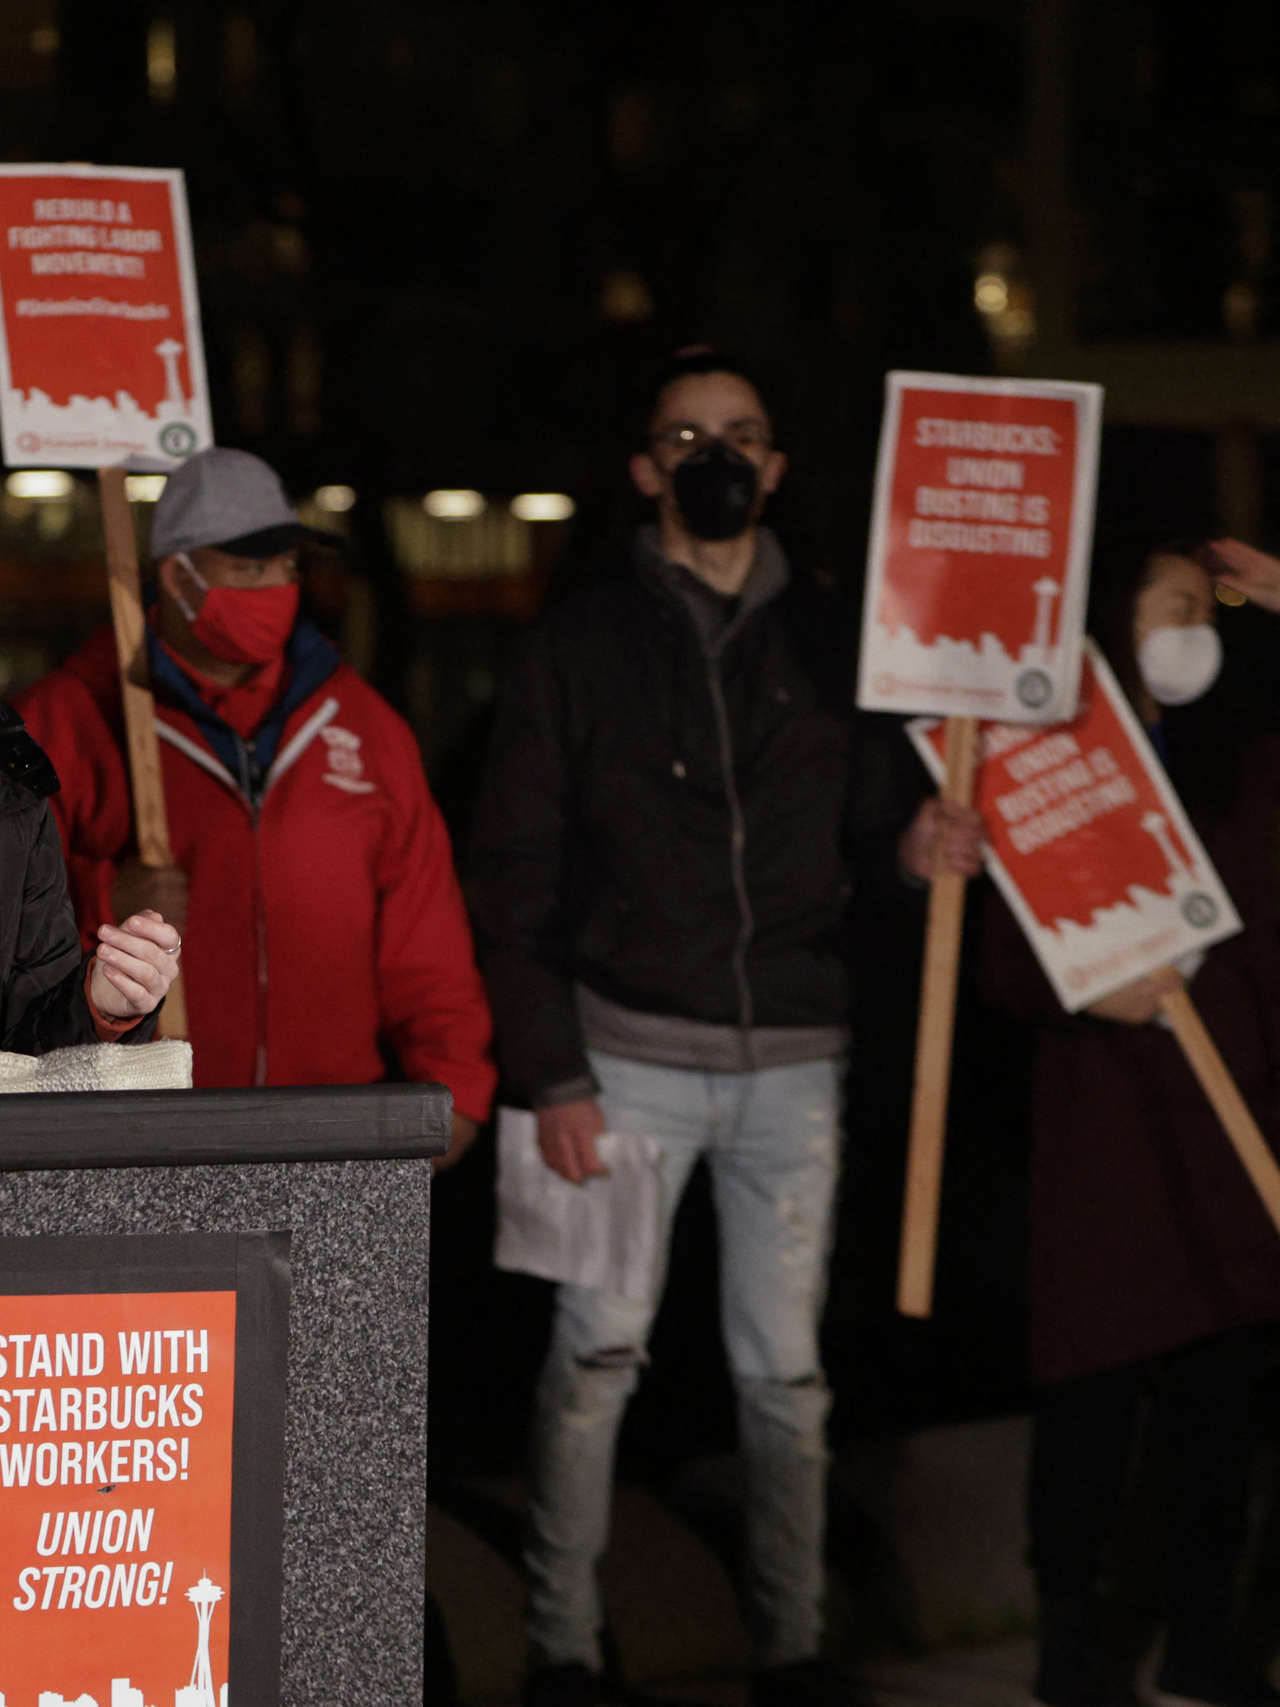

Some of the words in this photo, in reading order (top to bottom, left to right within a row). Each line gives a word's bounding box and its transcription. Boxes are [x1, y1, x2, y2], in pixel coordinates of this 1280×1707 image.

[118, 1329, 209, 1376] WITH
[0, 1437, 190, 1488] WORKERS!
[36, 1508, 155, 1556] UNION
[12, 1561, 174, 1611] STRONG!
